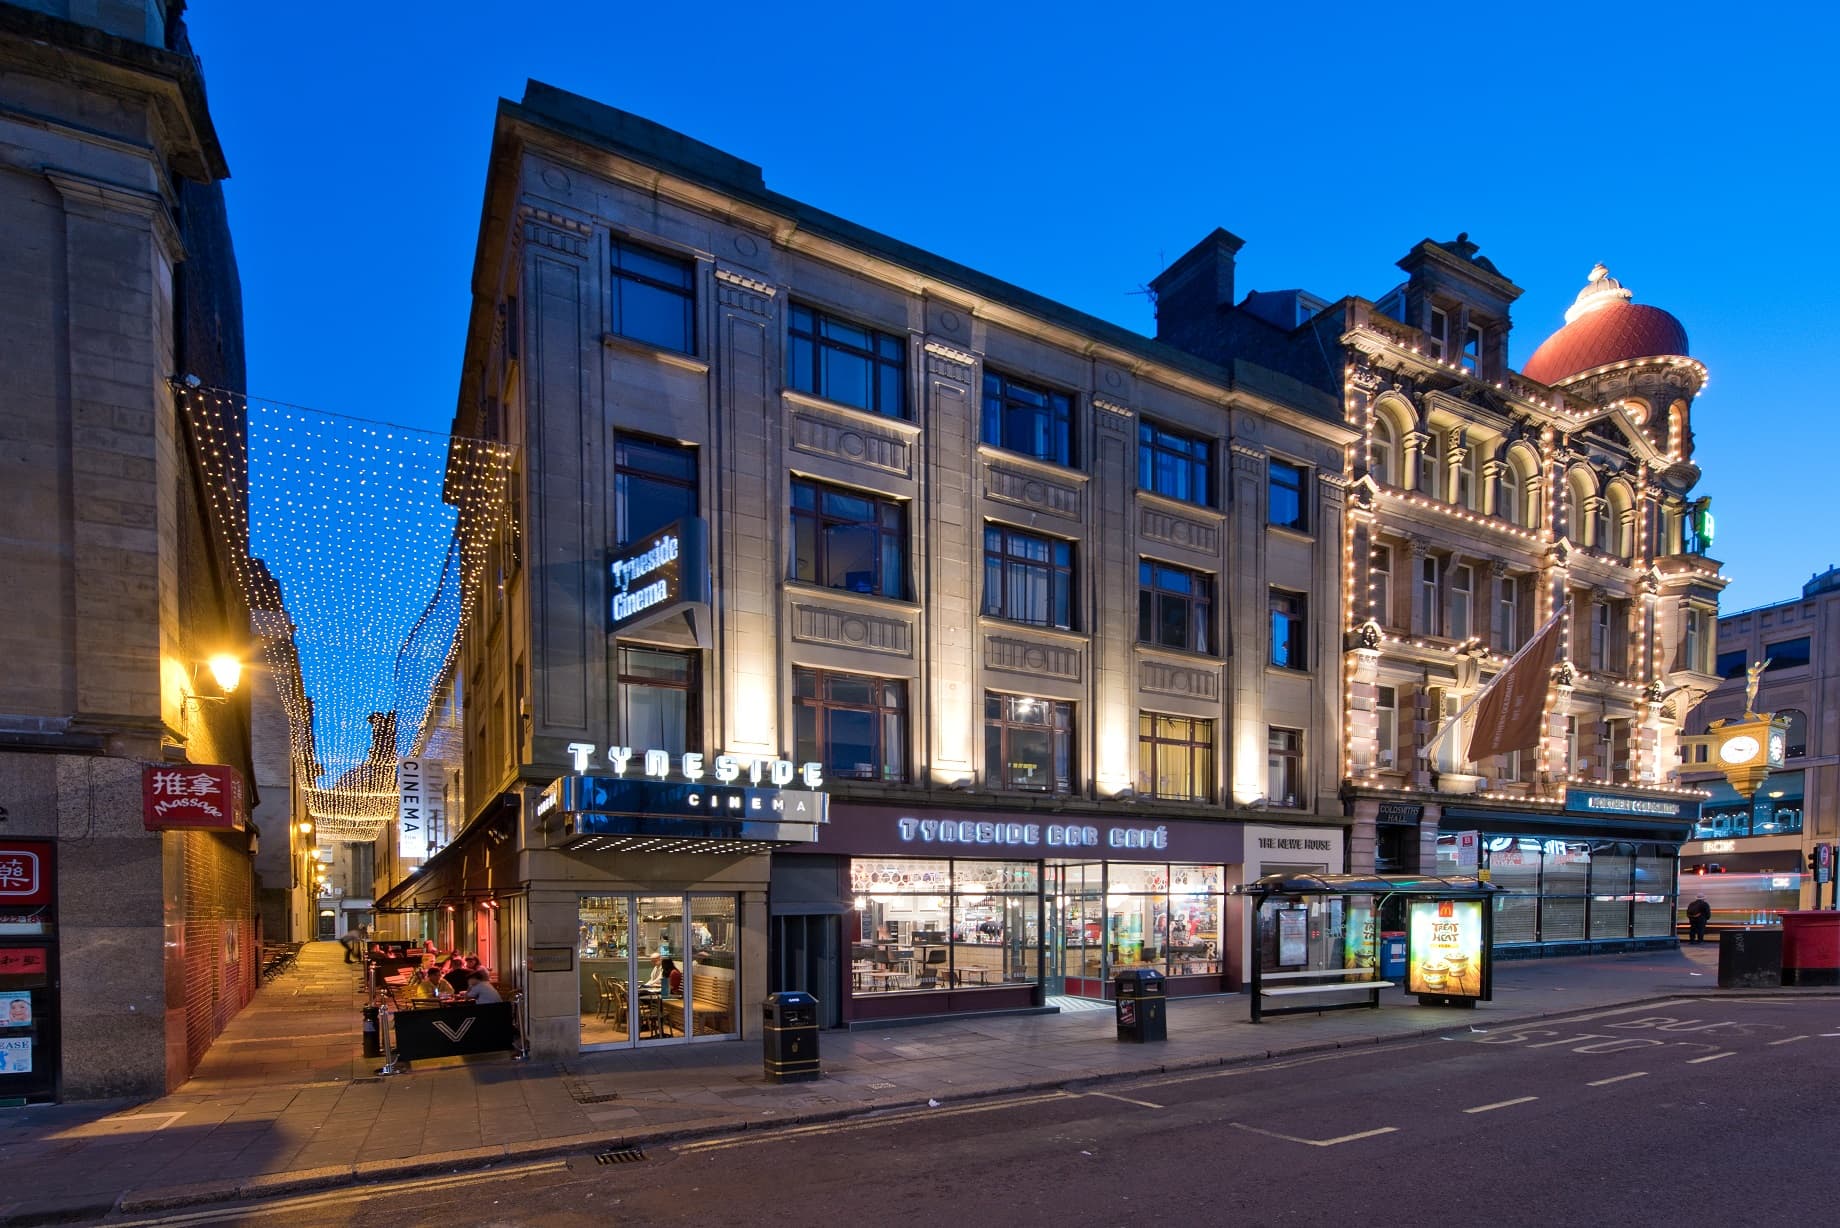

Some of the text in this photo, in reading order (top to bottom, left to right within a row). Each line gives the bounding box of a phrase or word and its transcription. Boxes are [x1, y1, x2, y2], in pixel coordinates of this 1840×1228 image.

[612, 535, 679, 591] Tyneside
[613, 579, 668, 621] Cinema
[567, 742, 824, 788] TYNESIDE
[152, 771, 222, 797] 推拿
[403, 761, 420, 833] CINEMA
[154, 797, 223, 817] Massage
[688, 793, 806, 812] CINEMA
[898, 817, 1168, 849] TYNESIDE BAR CAFÉ
[1387, 814, 1408, 823] HALL
[1258, 837, 1276, 849] THE
[1304, 839, 1331, 851] HOUSE
